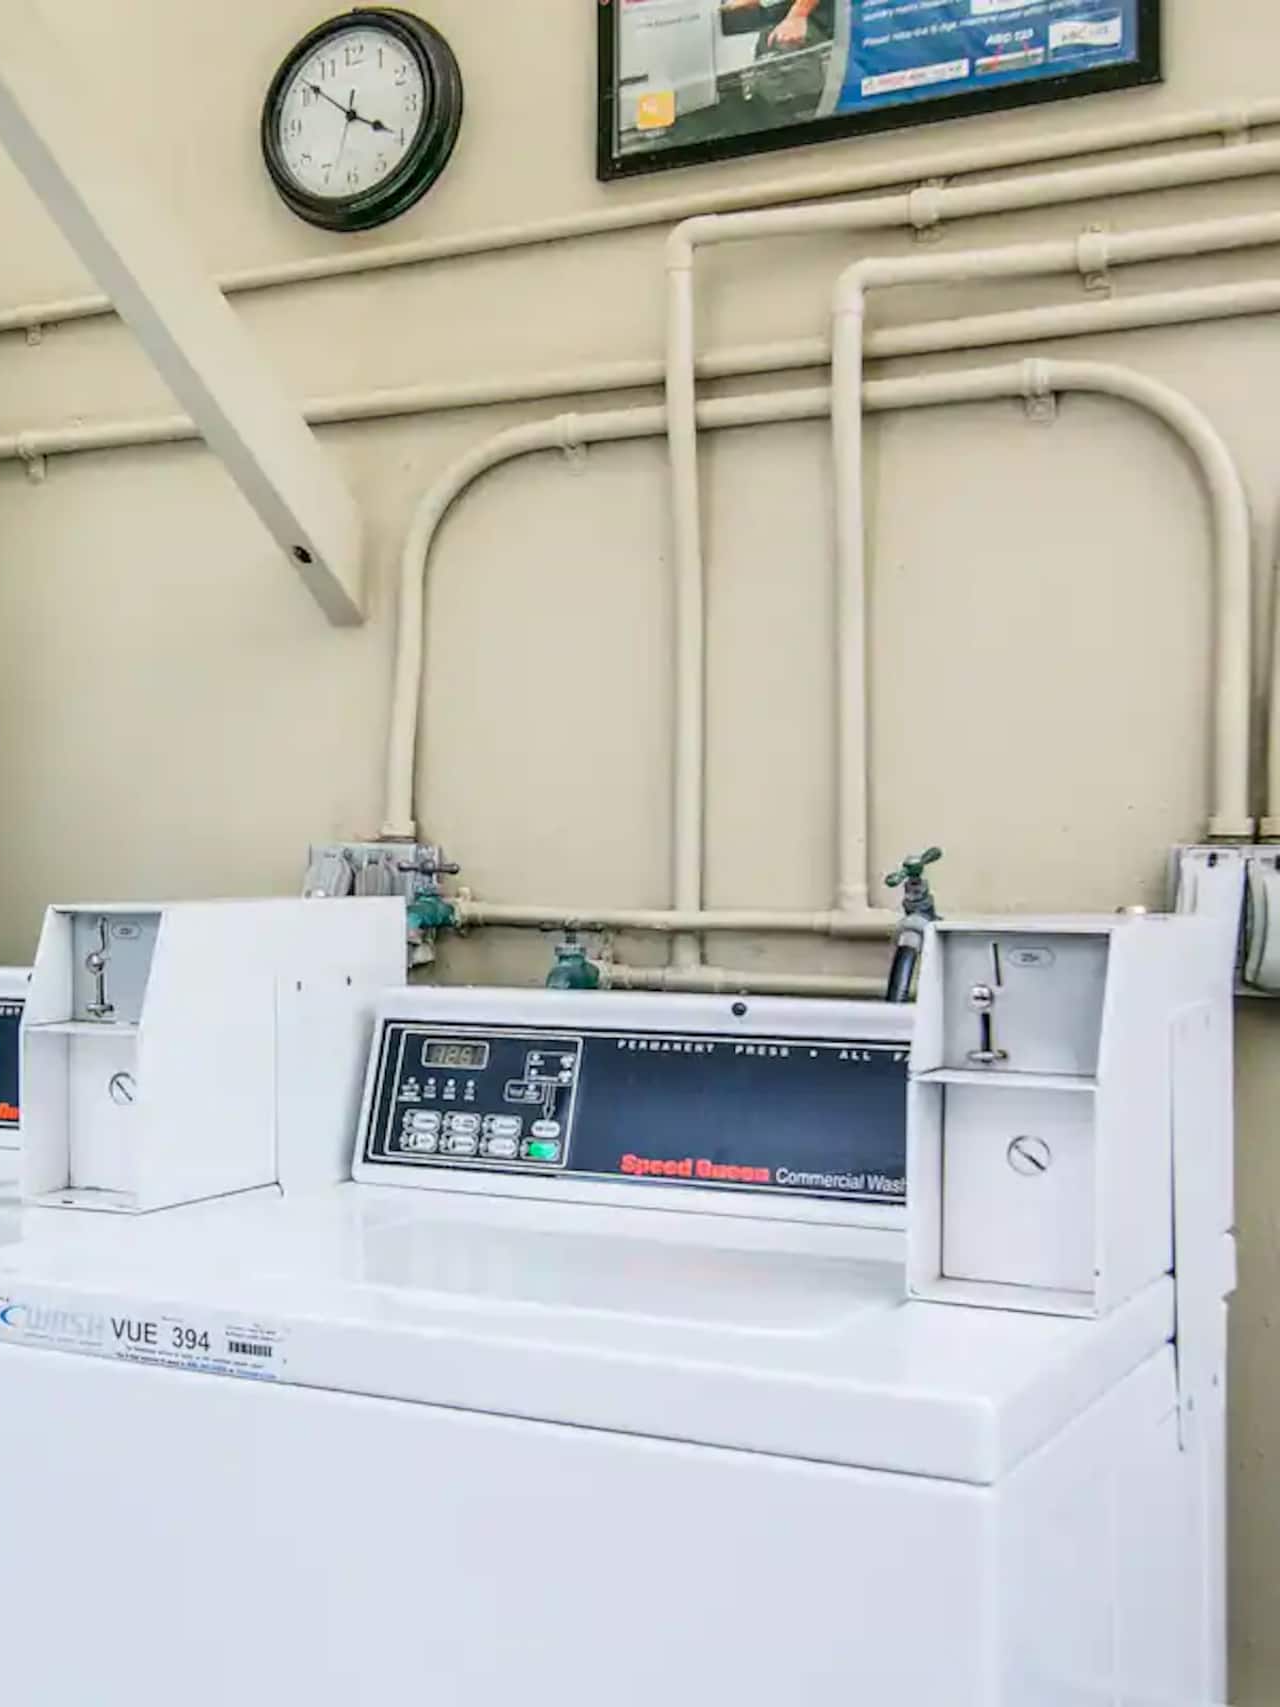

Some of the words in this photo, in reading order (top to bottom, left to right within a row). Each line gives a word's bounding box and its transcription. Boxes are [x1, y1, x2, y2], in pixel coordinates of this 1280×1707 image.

[344, 44, 364, 66] 12
[618, 1039, 716, 1053] PERMANENT
[734, 1044, 790, 1058] PRESS
[839, 1050, 871, 1063] ALL
[620, 1153, 693, 1176] Speed
[695, 1158, 771, 1184] Queen
[775, 1166, 866, 1191] Commercial
[110, 1317, 158, 1345] VUE
[171, 1326, 211, 1352] 394
